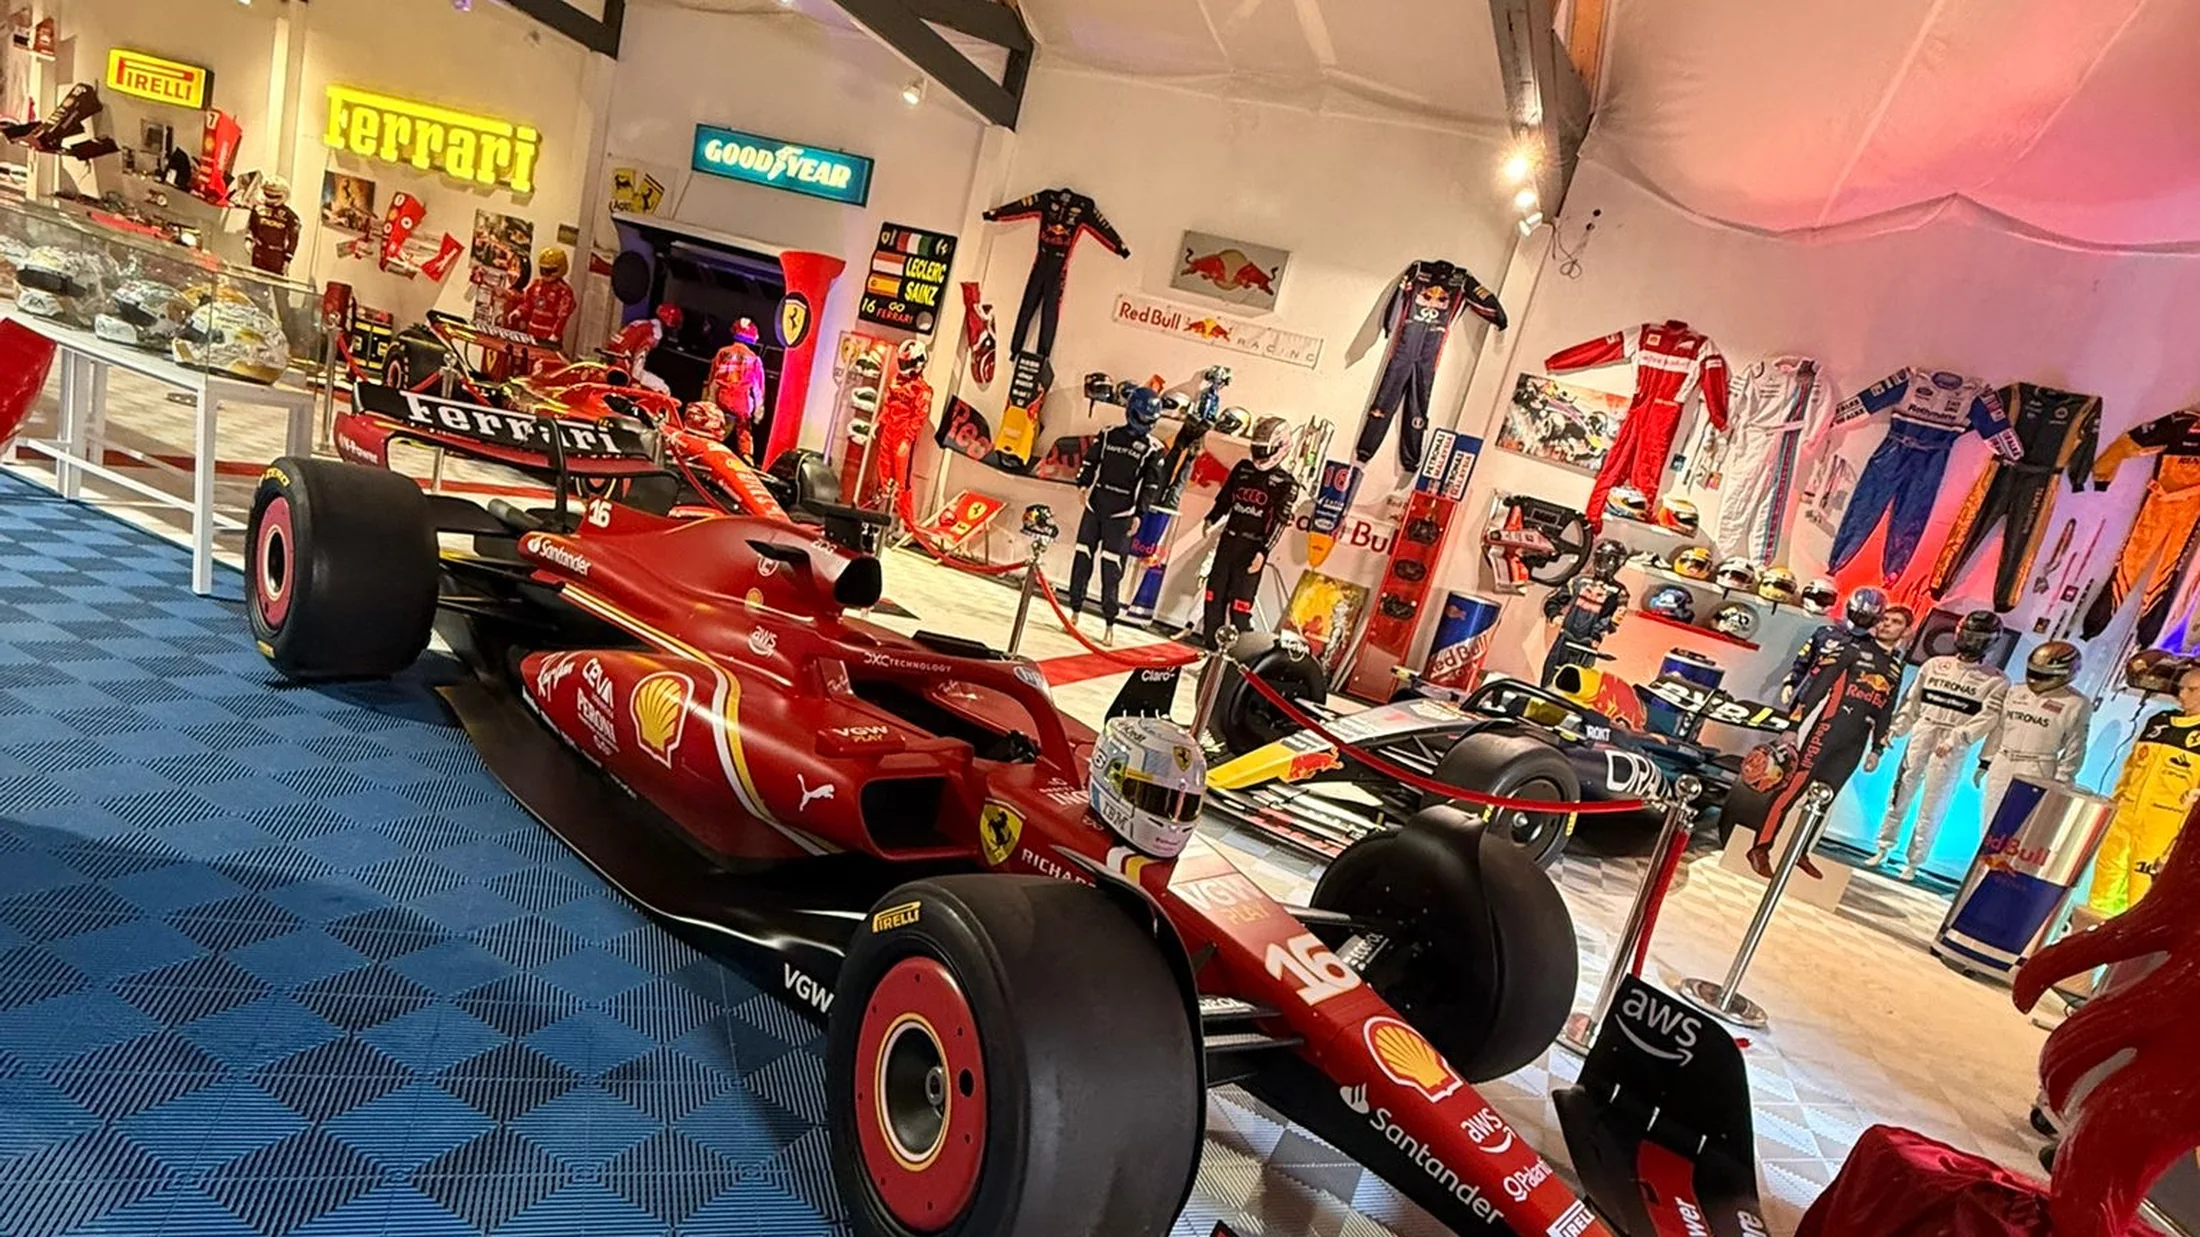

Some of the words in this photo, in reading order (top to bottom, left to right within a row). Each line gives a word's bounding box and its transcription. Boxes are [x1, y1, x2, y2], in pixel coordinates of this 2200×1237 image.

[116, 57, 194, 101] PIRELLI
[323, 84, 538, 193] Ferrari
[705, 139, 851, 188] GOODYEAR
[906, 257, 947, 283] LECLERC
[861, 298, 877, 313] 16
[904, 281, 939, 306] SAINZ
[876, 308, 914, 323] FERRARI
[1119, 302, 1150, 322] Red
[1150, 306, 1181, 330] Bull
[1236, 338, 1315, 362] RACING
[400, 390, 622, 454] Ferrari
[1425, 433, 1446, 475] PETRONAS
[1434, 436, 1454, 477] MALAYSIA
[588, 501, 612, 528] 16
[1351, 520, 1400, 556] Bul
[540, 539, 592, 577] Santander
[890, 658, 951, 672] TECHNOLOGY
[1141, 669, 1171, 682] Claro
[1927, 676, 1977, 696] PETRONAS
[831, 725, 888, 737] VGW
[853, 733, 883, 743] PLAY
[1102, 801, 1129, 831] IBM
[1021, 848, 1097, 889] RICHA
[872, 900, 921, 933] PIRELLI
[783, 963, 835, 1013] VGW
[1264, 932, 1363, 1007] 16
[1622, 987, 1702, 1048] aws
[1461, 1107, 1503, 1144] aws
[1369, 1107, 1504, 1225] Santander
